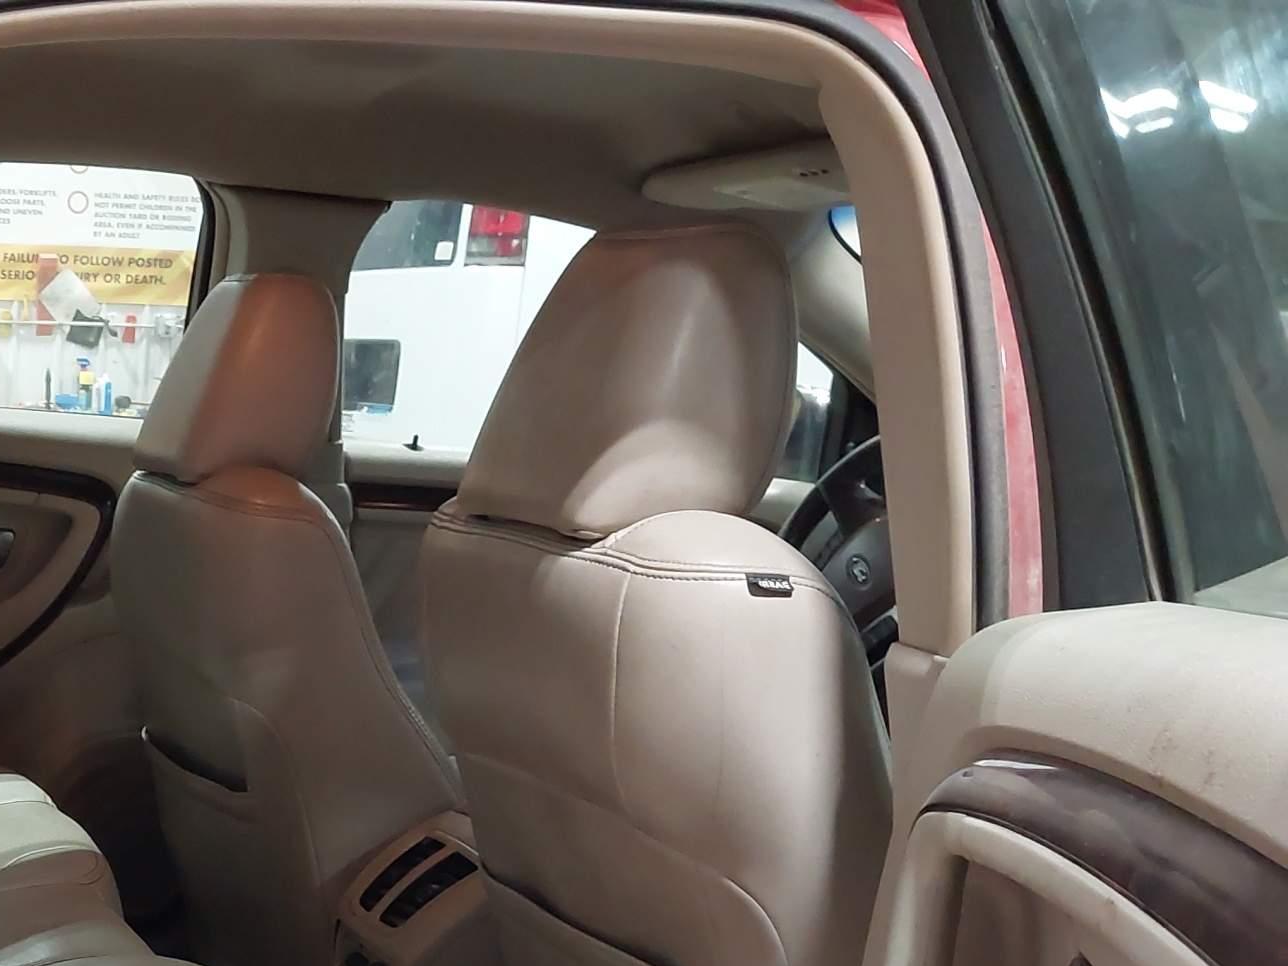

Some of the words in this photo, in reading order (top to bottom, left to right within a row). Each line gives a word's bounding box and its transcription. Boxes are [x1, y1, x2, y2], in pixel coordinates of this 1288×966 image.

[12, 208, 43, 216] UNEVEN
[73, 254, 124, 267] FOLLOW
[128, 257, 173, 269] POSTED
[0, 269, 36, 281] SERIO
[104, 272, 121, 284] OR
[125, 273, 166, 285] DEATH.
